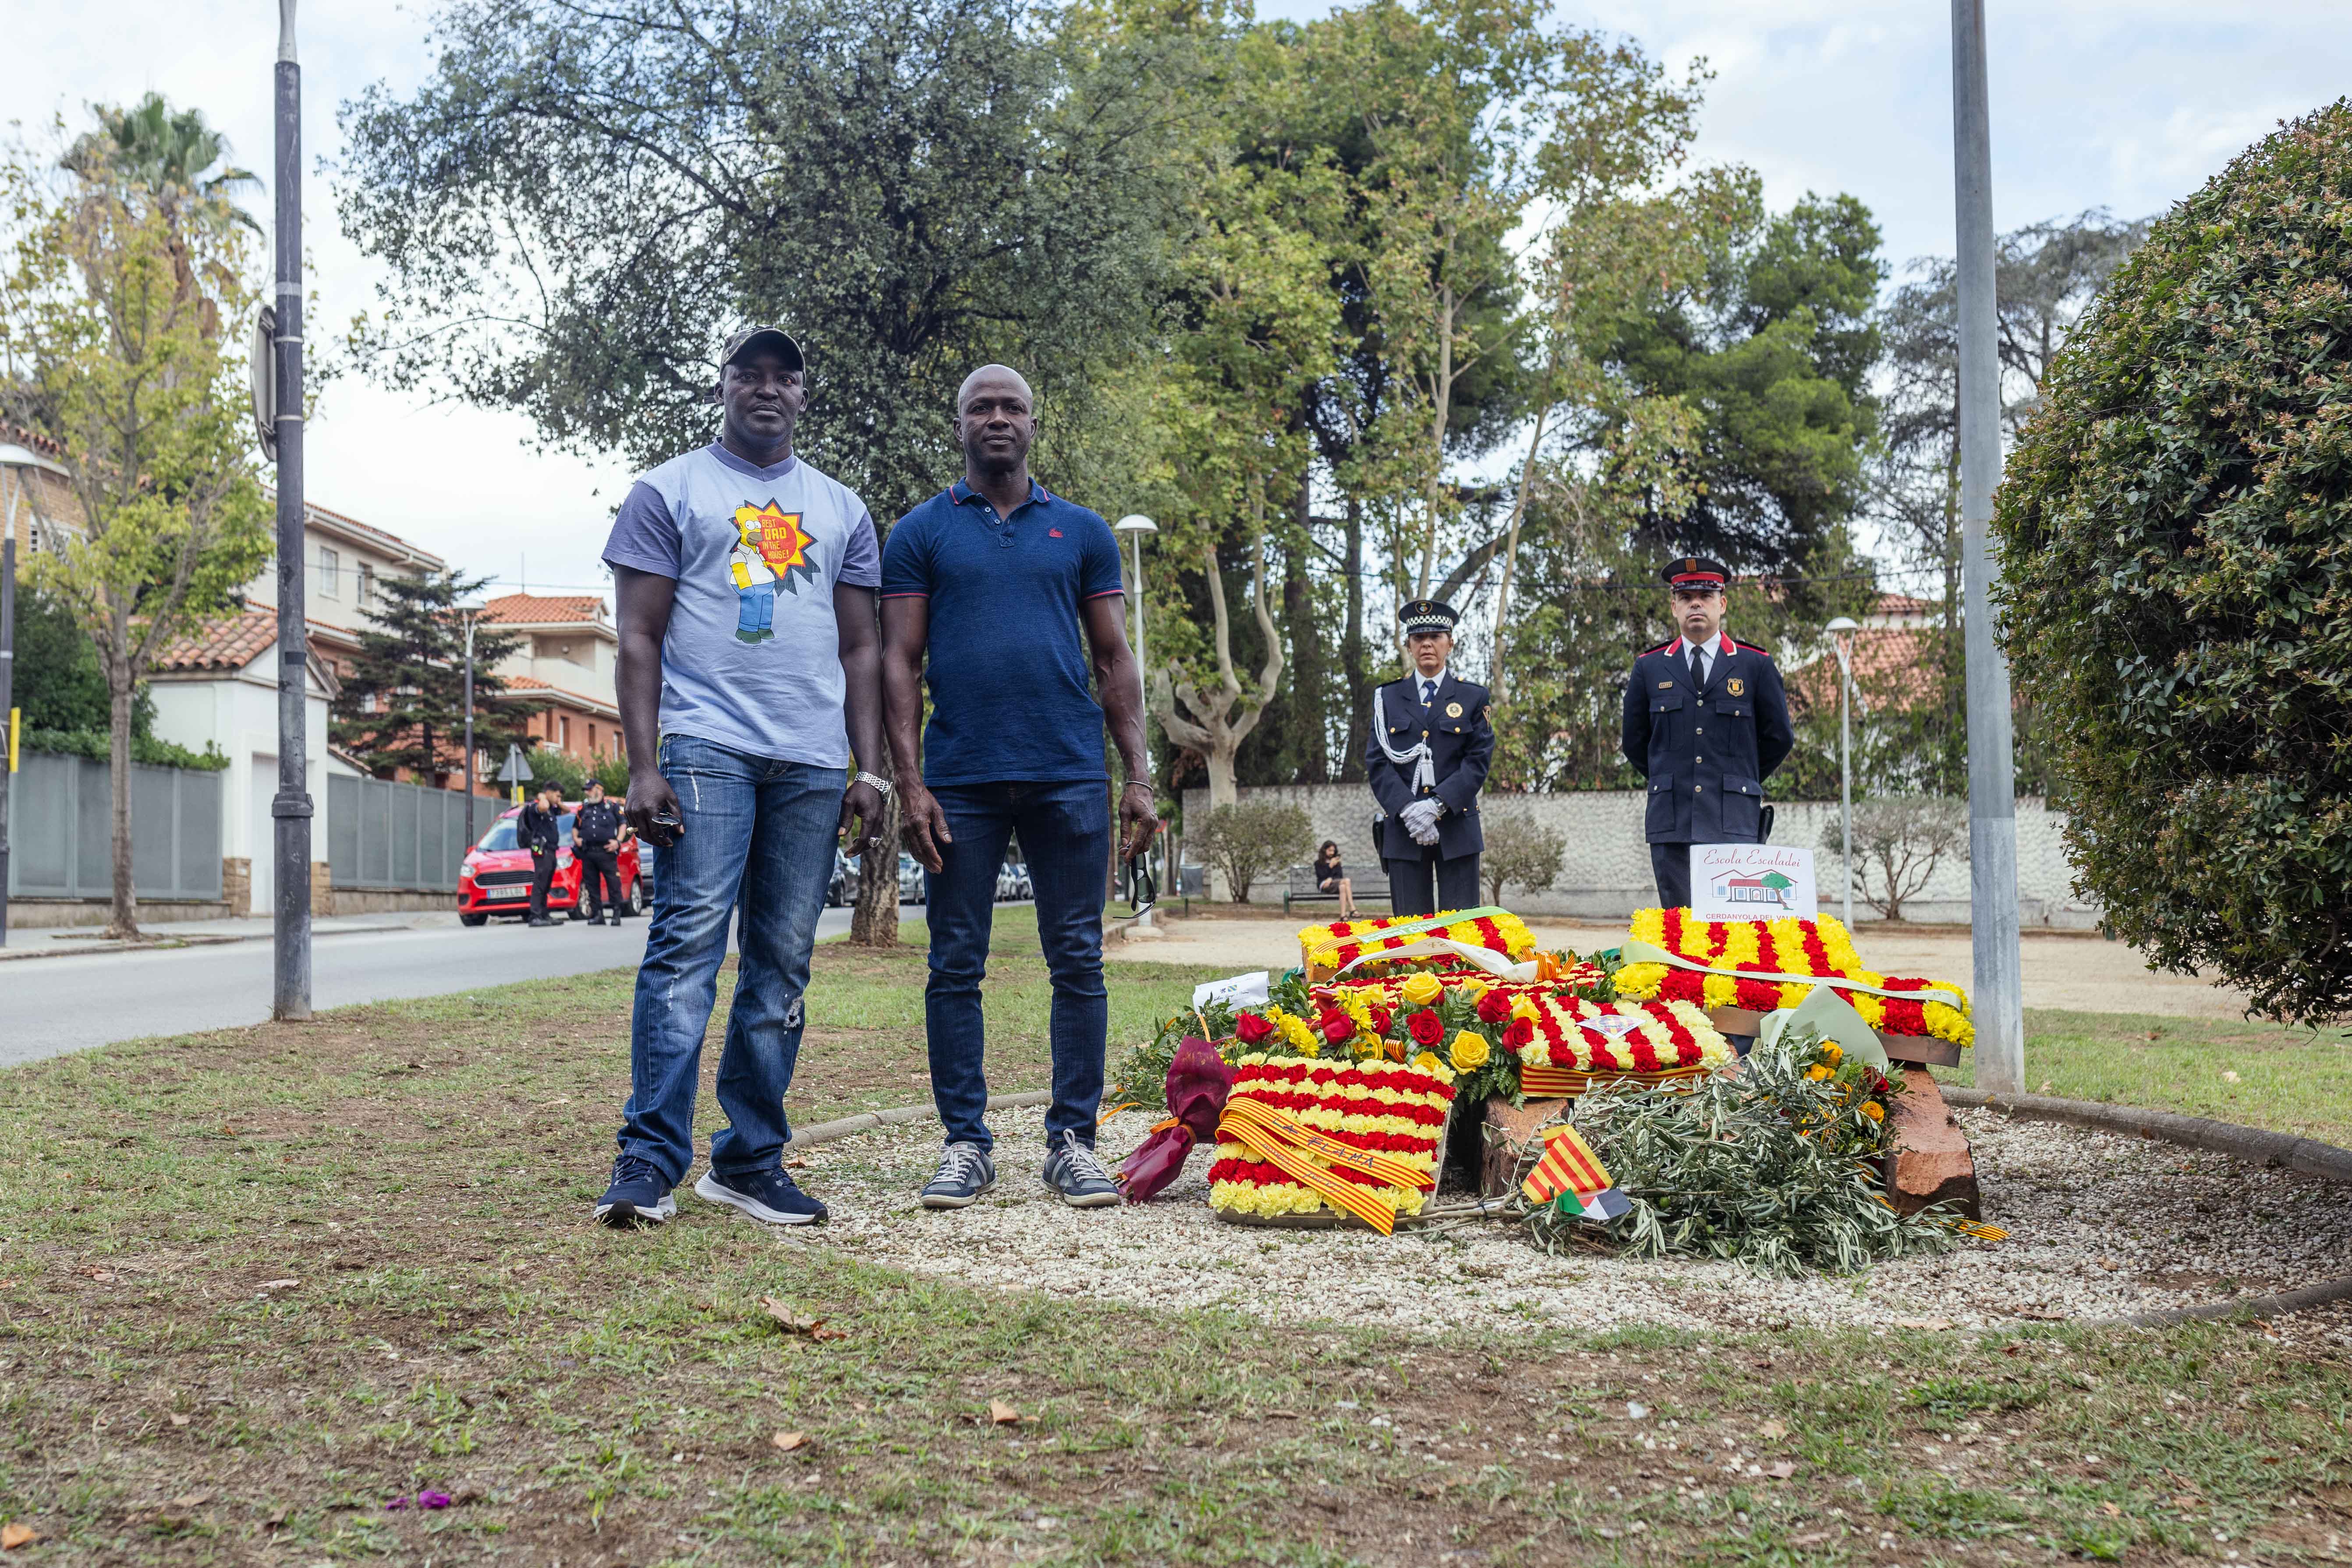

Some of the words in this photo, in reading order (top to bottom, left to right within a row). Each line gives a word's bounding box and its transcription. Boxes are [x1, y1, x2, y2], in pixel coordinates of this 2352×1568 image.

[762, 519, 776, 527] BEST
[765, 527, 787, 540] DAD
[762, 541, 769, 549] IN
[769, 541, 780, 549] THE
[768, 549, 789, 559] HOUSE!
[1704, 849, 1741, 864] Escola
[1746, 849, 1800, 867] Escaladei
[1409, 923, 1441, 932] Club
[1272, 1117, 1298, 1134] LA
[1307, 1136, 1380, 1168] FLAMA
